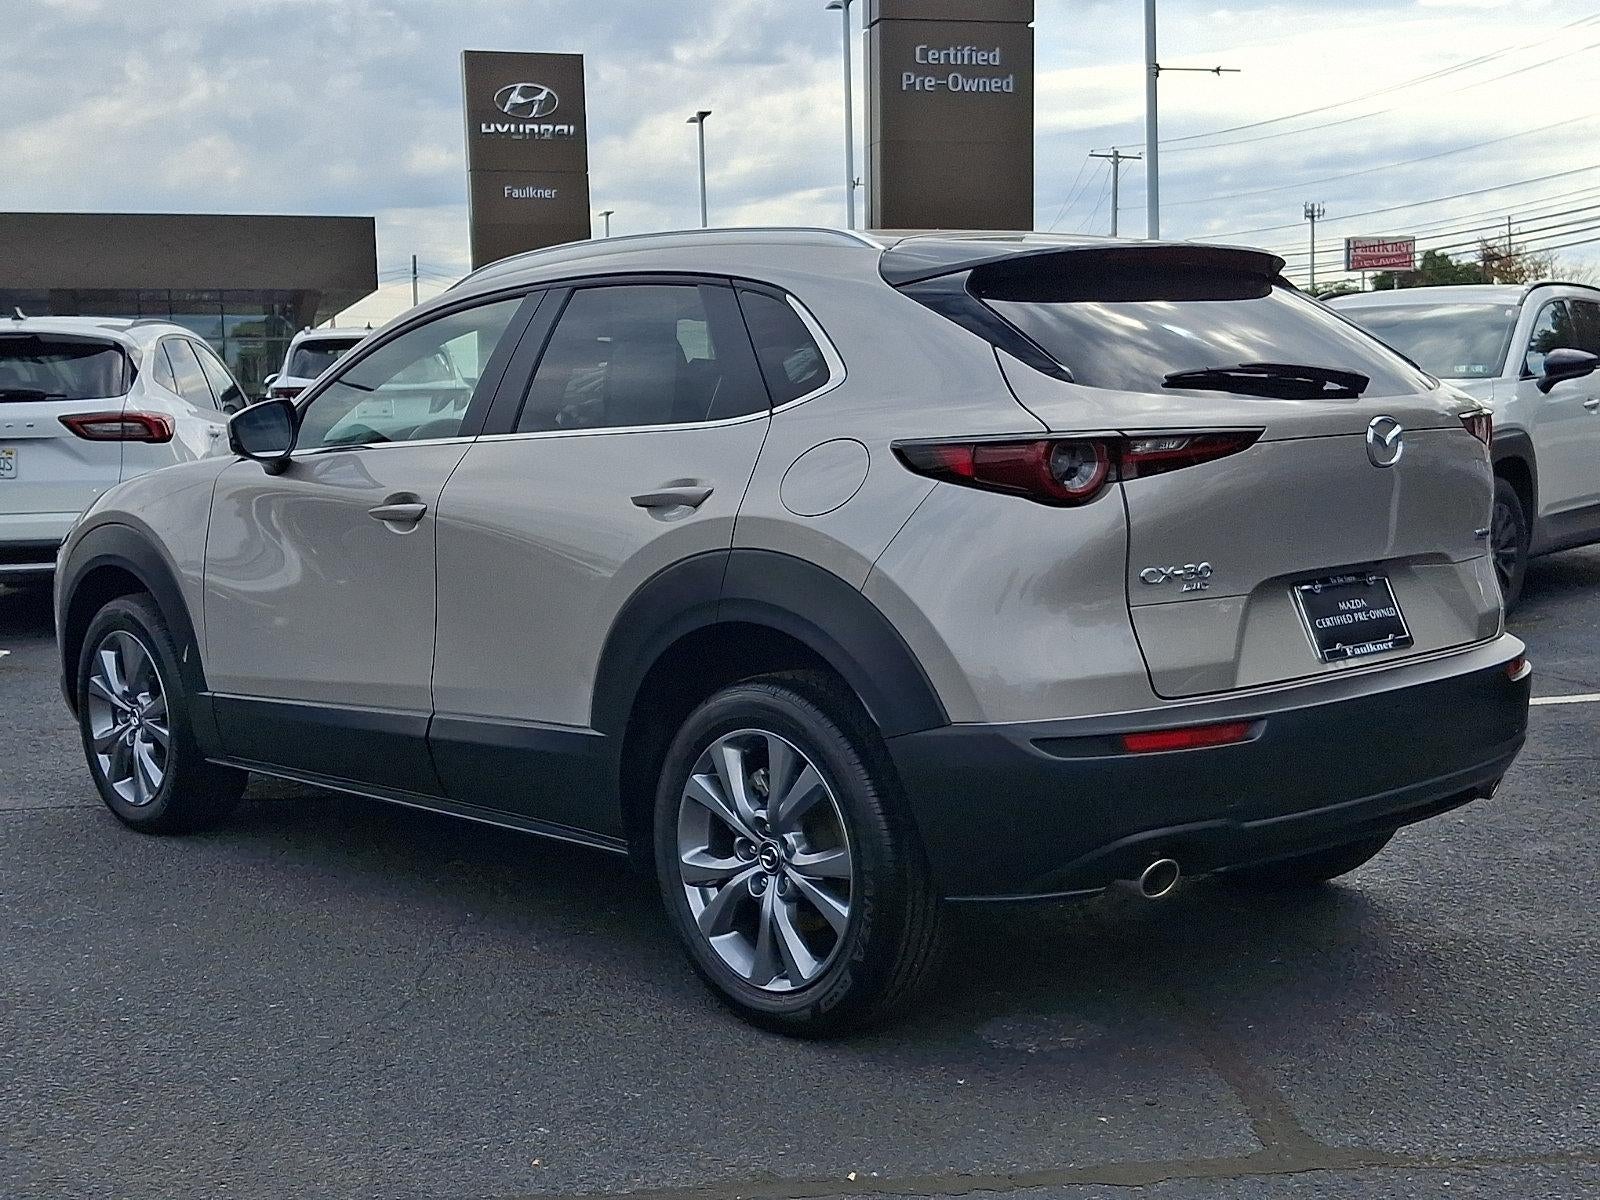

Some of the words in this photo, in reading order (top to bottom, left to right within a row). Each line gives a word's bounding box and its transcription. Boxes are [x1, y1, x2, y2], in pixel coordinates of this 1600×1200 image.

[914, 45, 1000, 65] Certified
[902, 72, 1013, 92] Pre-Owned
[504, 185, 557, 198] Faulkner
[1139, 561, 1213, 584] CX-30
[1338, 599, 1367, 610] MAZDA
[1315, 614, 1353, 628] CERTIFIED
[1353, 607, 1396, 622] PRE-OWNED
[1345, 641, 1394, 656] Faulkner
